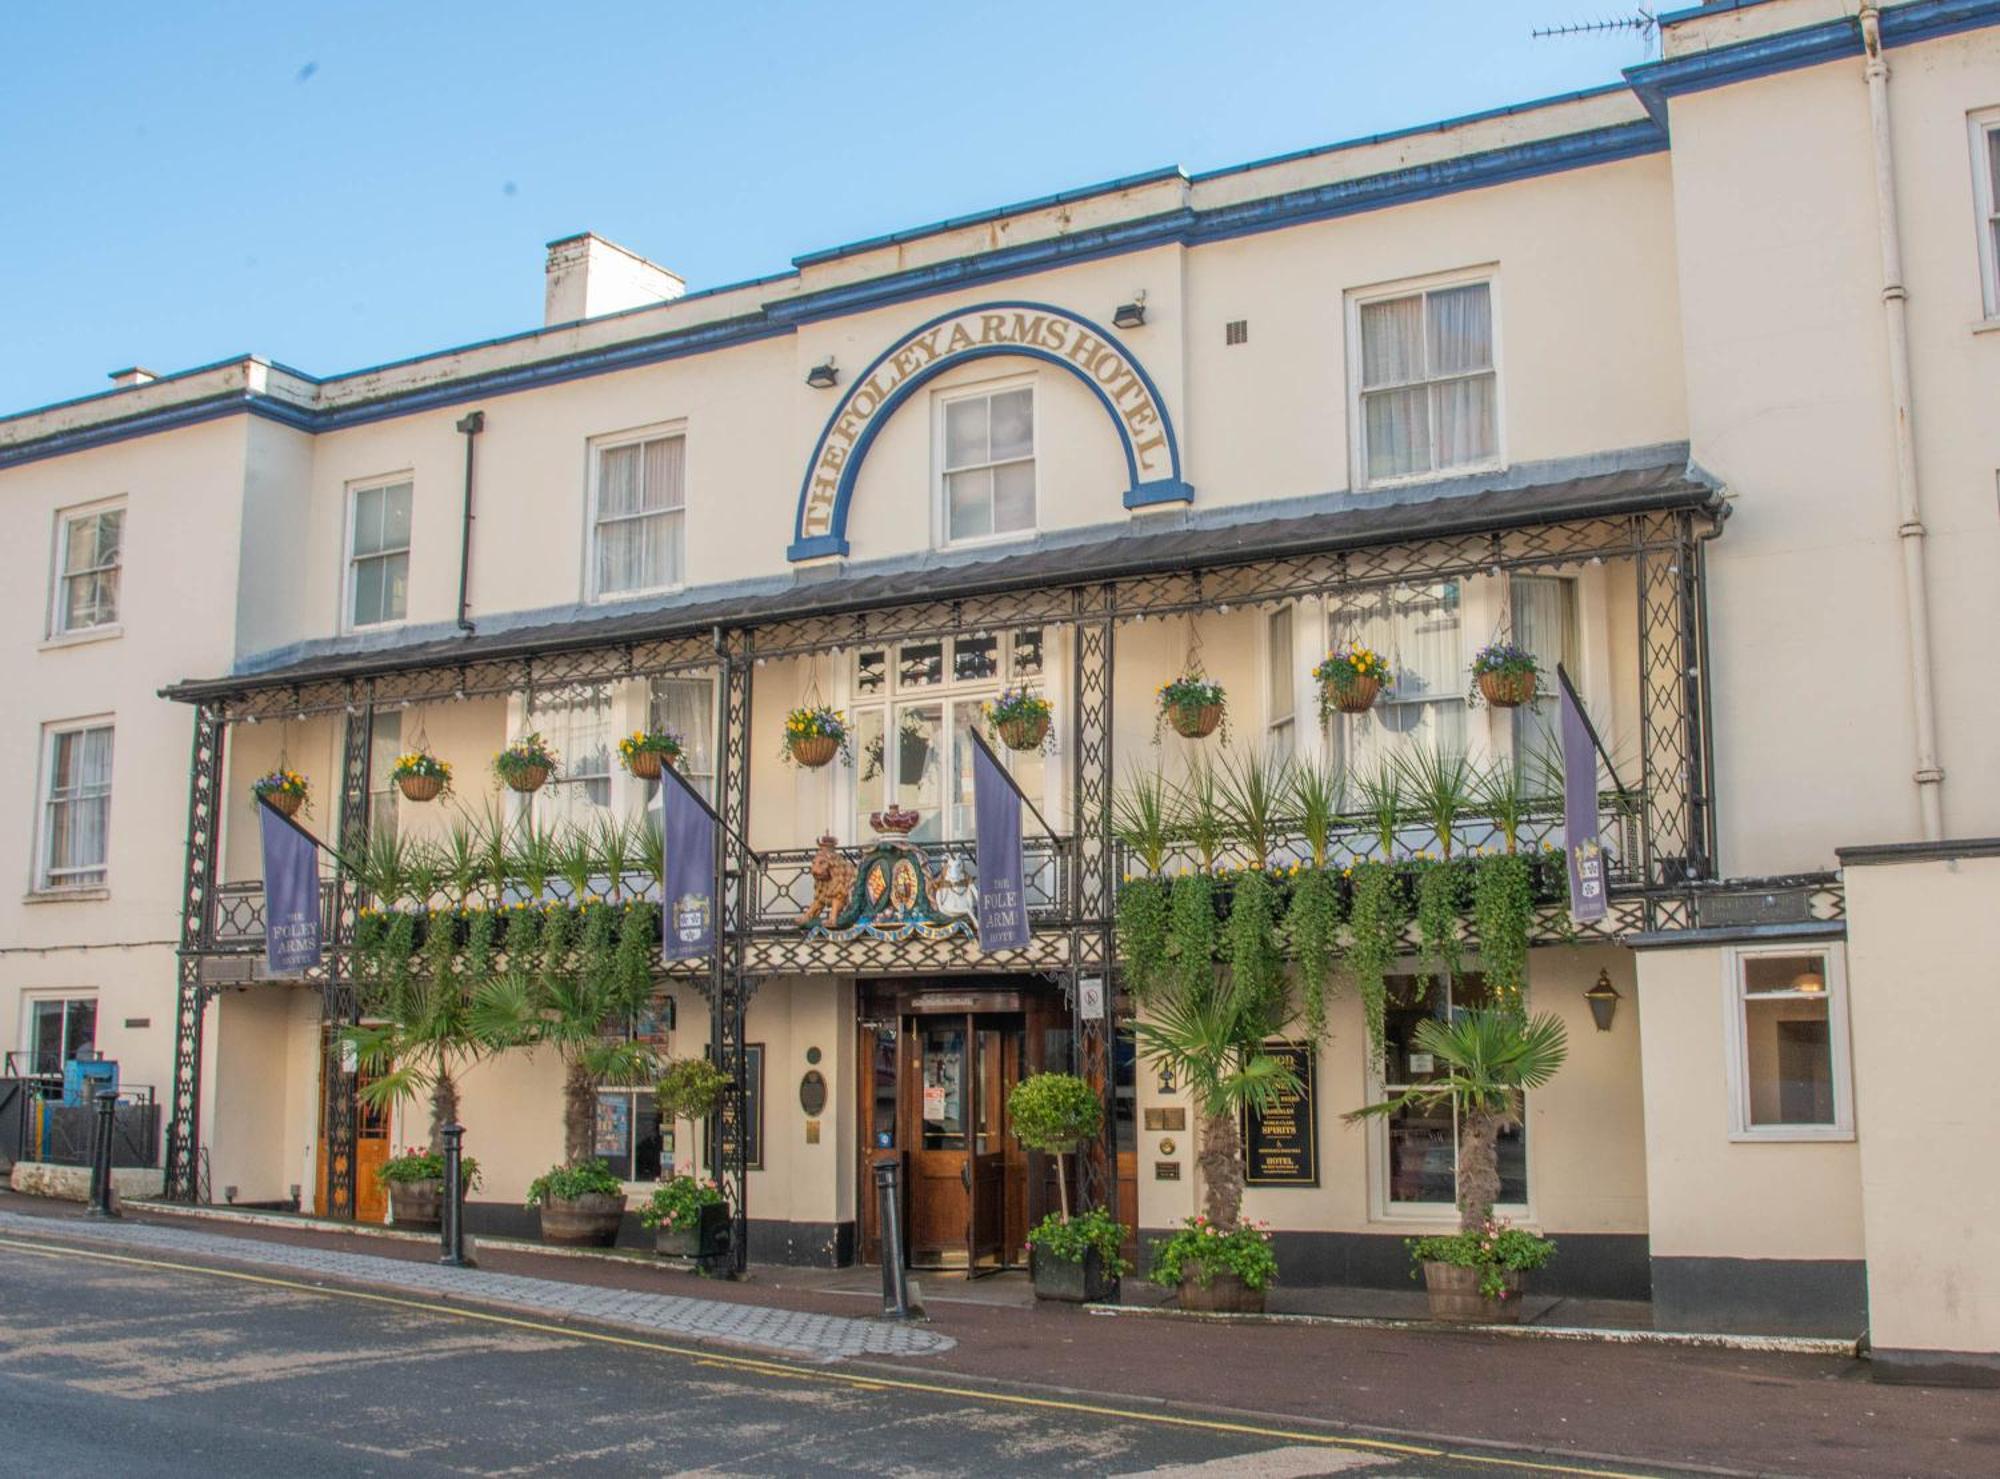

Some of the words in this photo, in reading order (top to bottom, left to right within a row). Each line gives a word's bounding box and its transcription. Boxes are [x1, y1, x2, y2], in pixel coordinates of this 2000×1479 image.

[805, 443, 848, 536] THE
[831, 330, 940, 446] FOLEY
[946, 313, 1070, 354] ARMS
[1064, 330, 1167, 470] HOTEL
[984, 891, 1017, 910] FOLE
[272, 921, 318, 939] FOLEY
[277, 937, 316, 954] ARMS
[1262, 1126, 1297, 1135] SPIRITS
[1265, 1157, 1294, 1165] HOTEL
